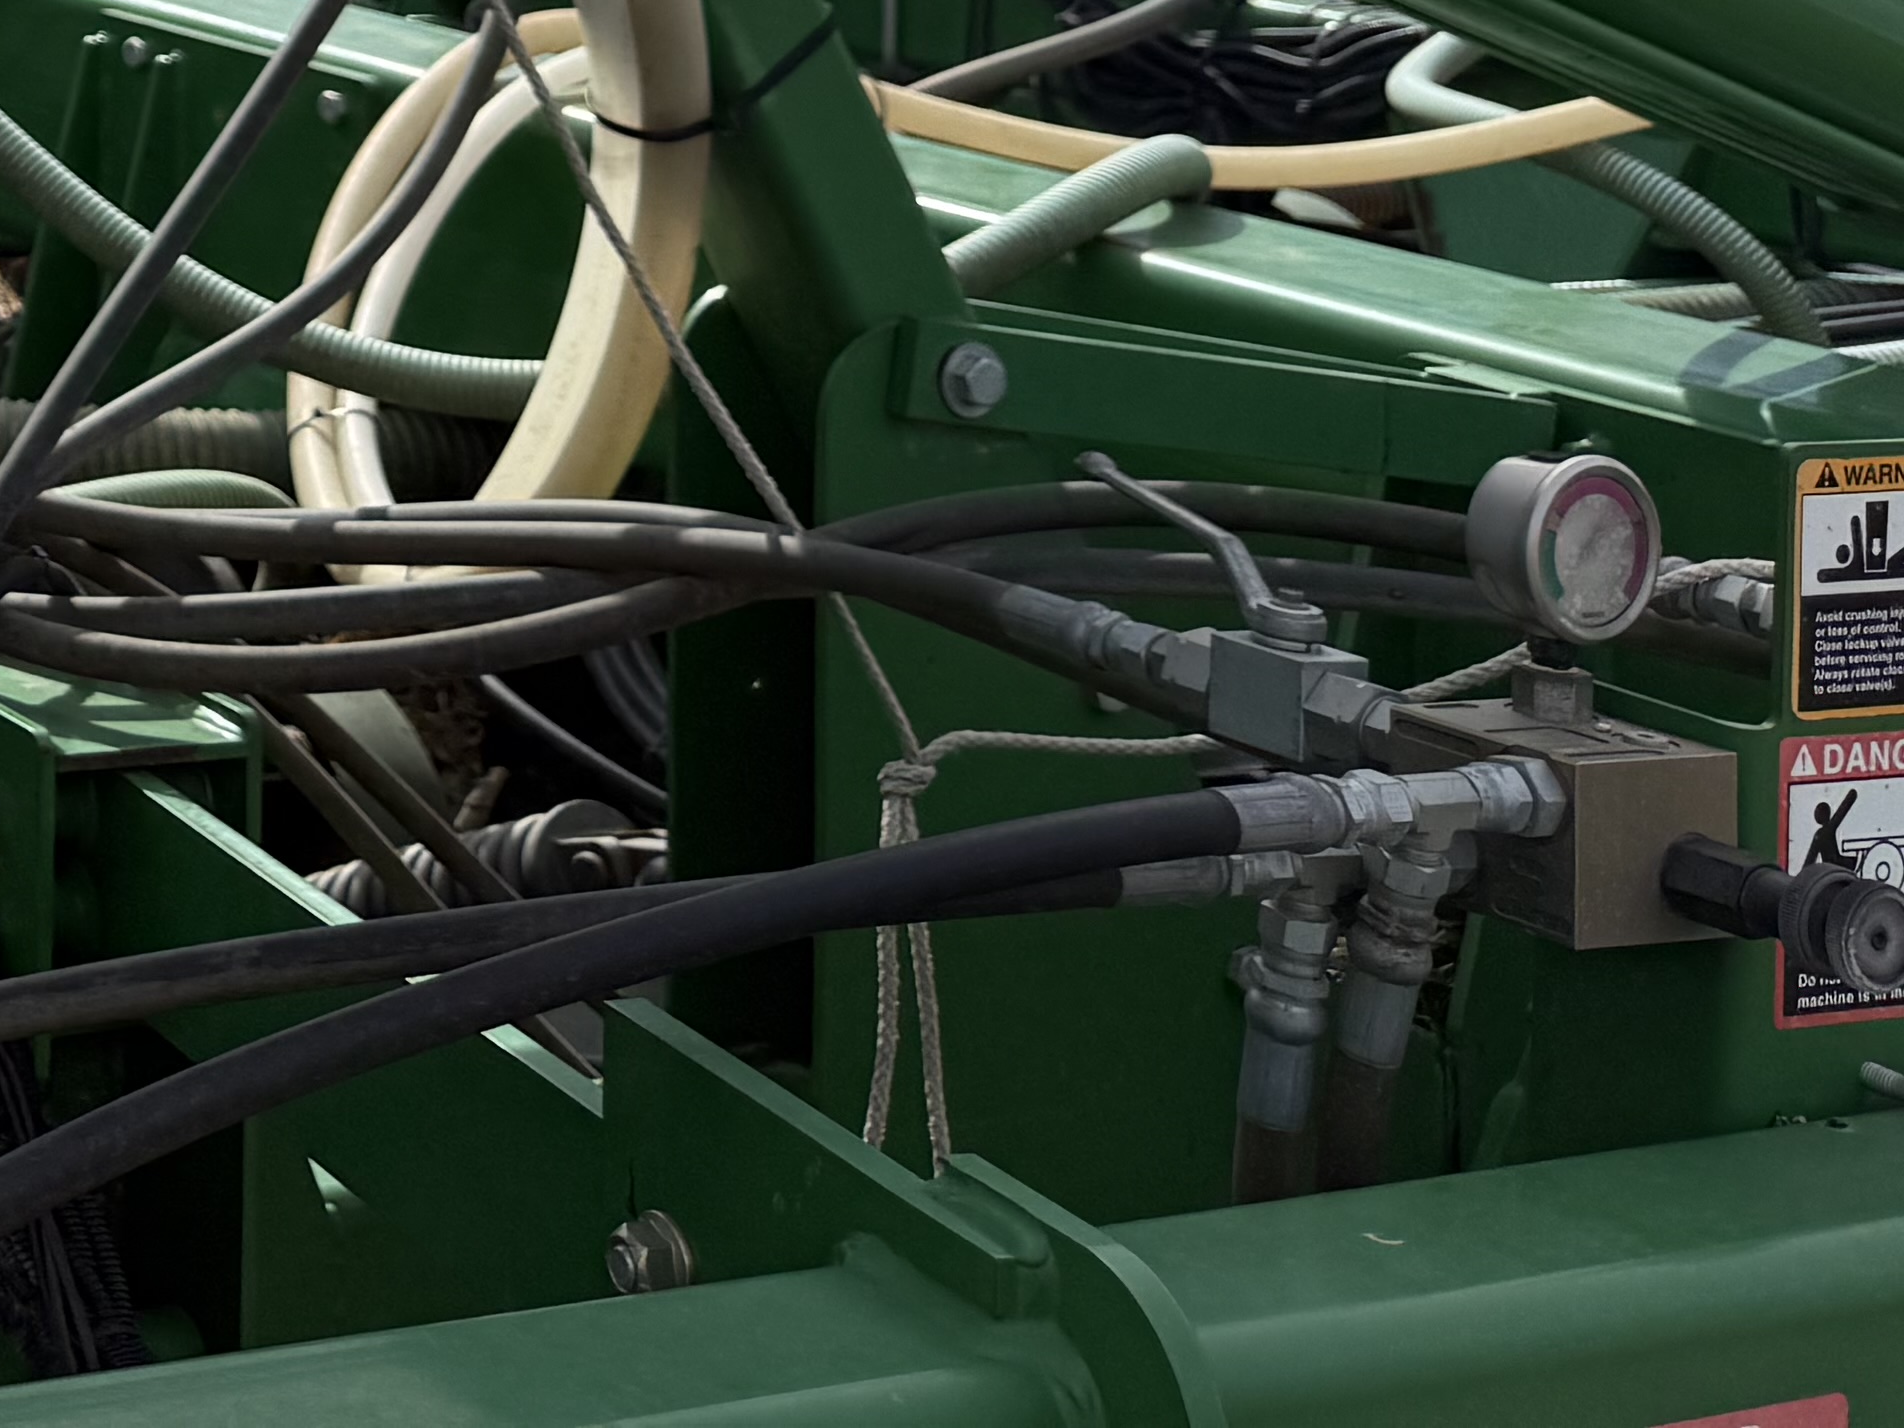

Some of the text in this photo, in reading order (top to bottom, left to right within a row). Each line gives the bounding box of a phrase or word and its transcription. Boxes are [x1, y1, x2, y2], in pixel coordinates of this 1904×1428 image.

[1844, 463, 1904, 486] WARN
[1797, 974, 1816, 988] Do
[1797, 989, 1854, 1009] machine
